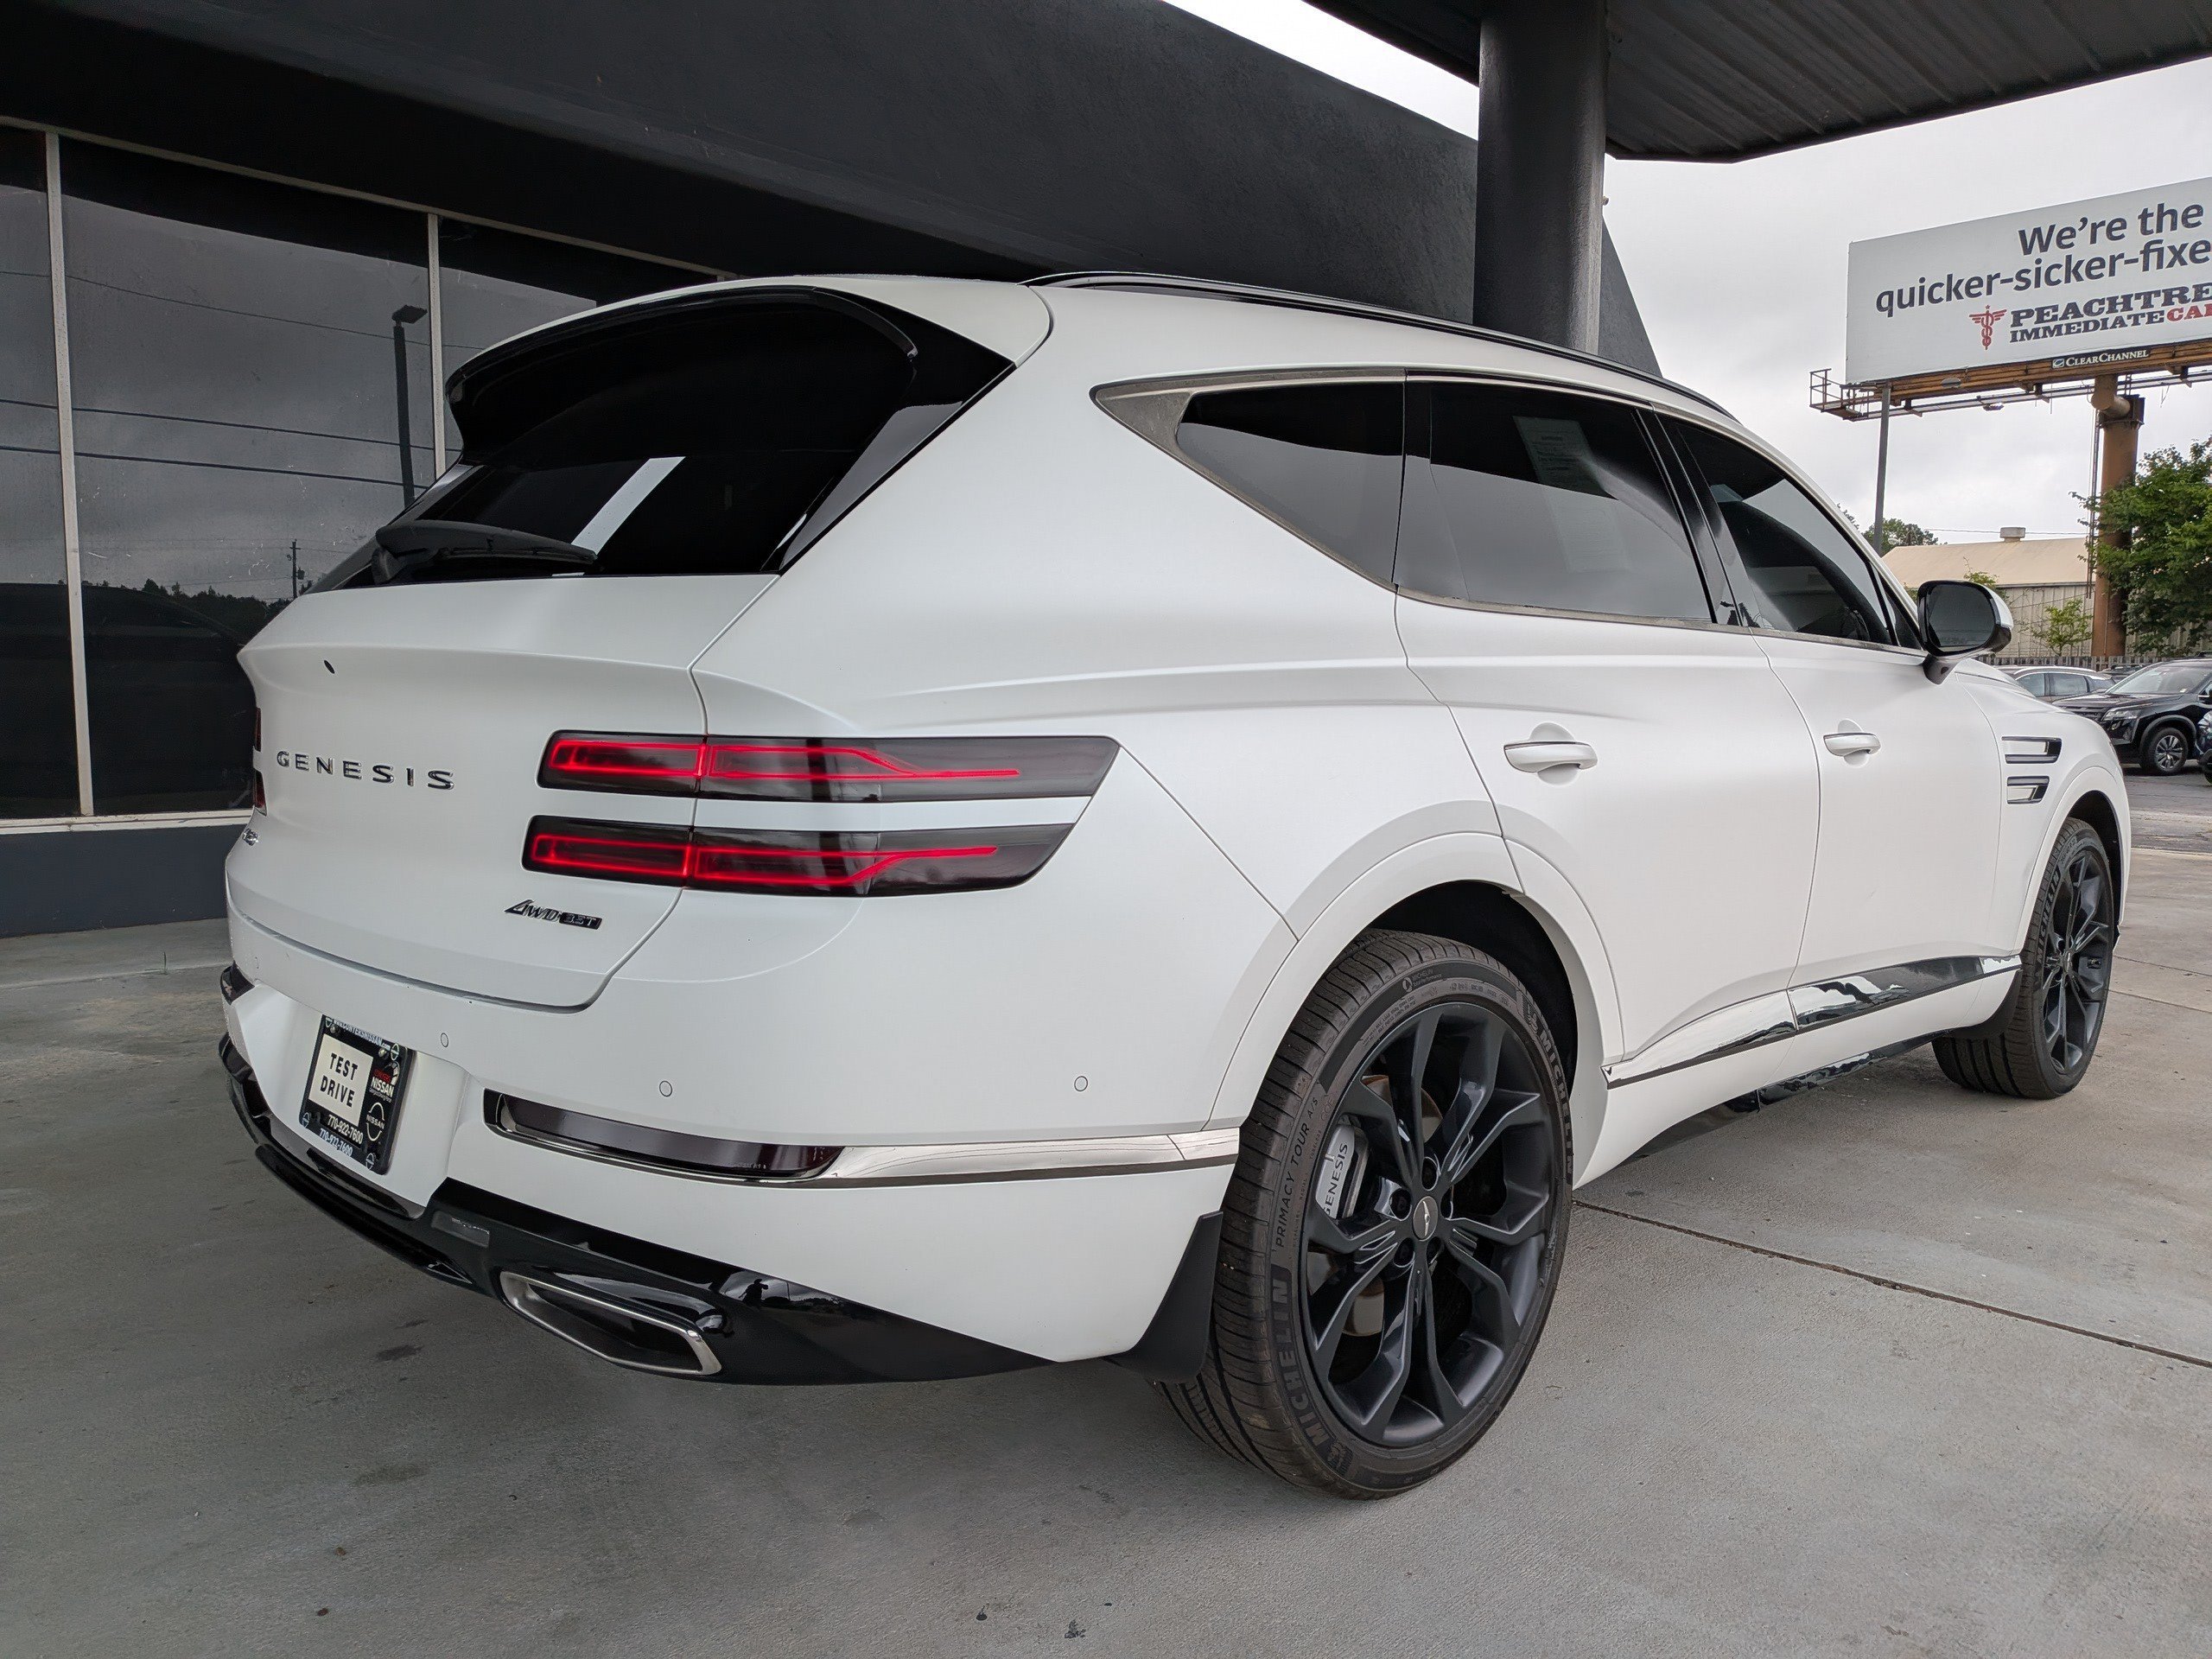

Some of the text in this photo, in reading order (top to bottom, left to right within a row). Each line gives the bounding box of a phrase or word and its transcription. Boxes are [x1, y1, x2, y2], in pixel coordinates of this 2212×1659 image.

[2018, 203, 2204, 256] We're the
[276, 750, 454, 791] GENESIS
[505, 899, 561, 923] AWD
[2035, 869, 2061, 963] MICHELIN
[330, 1052, 359, 1081] TEST
[320, 1075, 355, 1108] DRIVE
[370, 1076, 395, 1098] NISSAN
[1539, 1029, 1573, 1175] MICHELIN
[327, 1114, 364, 1145] 770-922-7600
[365, 1114, 385, 1130] NISSAN
[1275, 1096, 1319, 1248] PRIMACY TOUR A/S
[1272, 1279, 1331, 1448] MICHELIN
